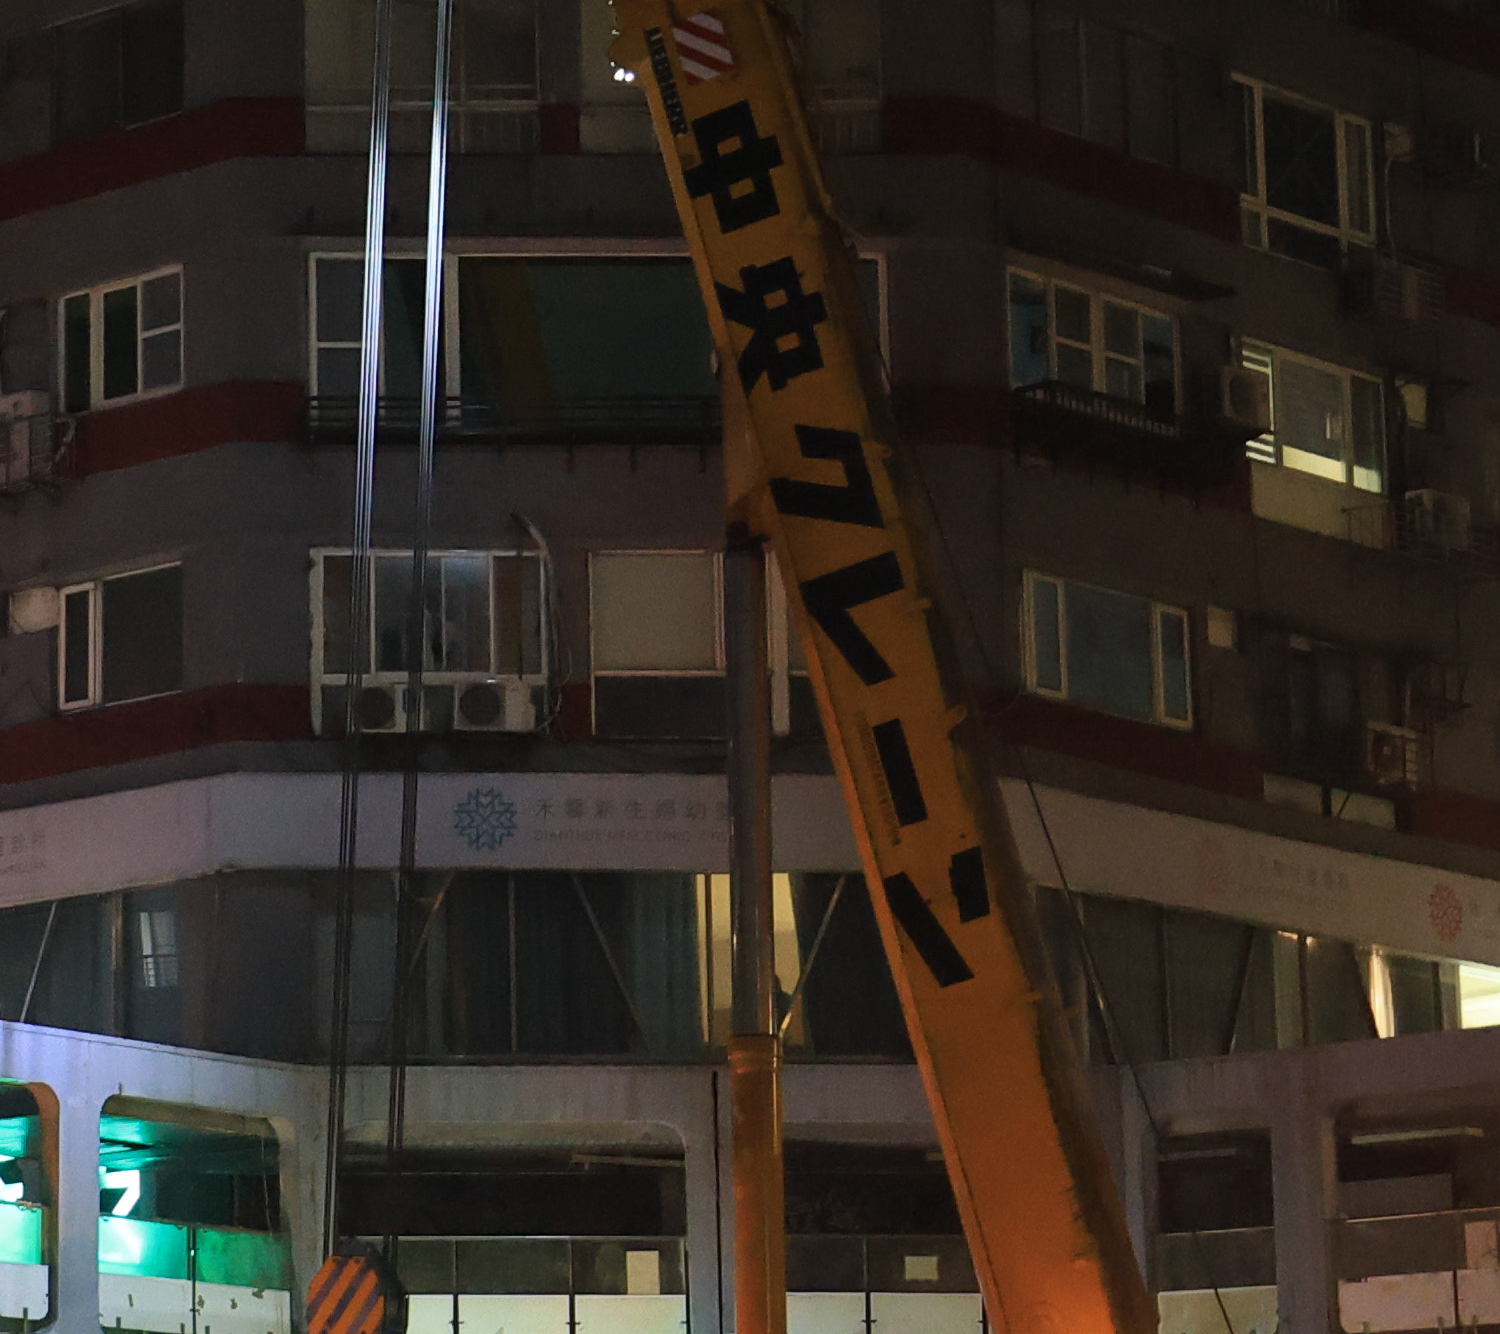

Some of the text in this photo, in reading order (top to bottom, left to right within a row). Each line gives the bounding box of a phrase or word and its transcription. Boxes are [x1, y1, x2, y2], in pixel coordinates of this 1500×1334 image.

[685, 99, 992, 988] 中央クレーン
